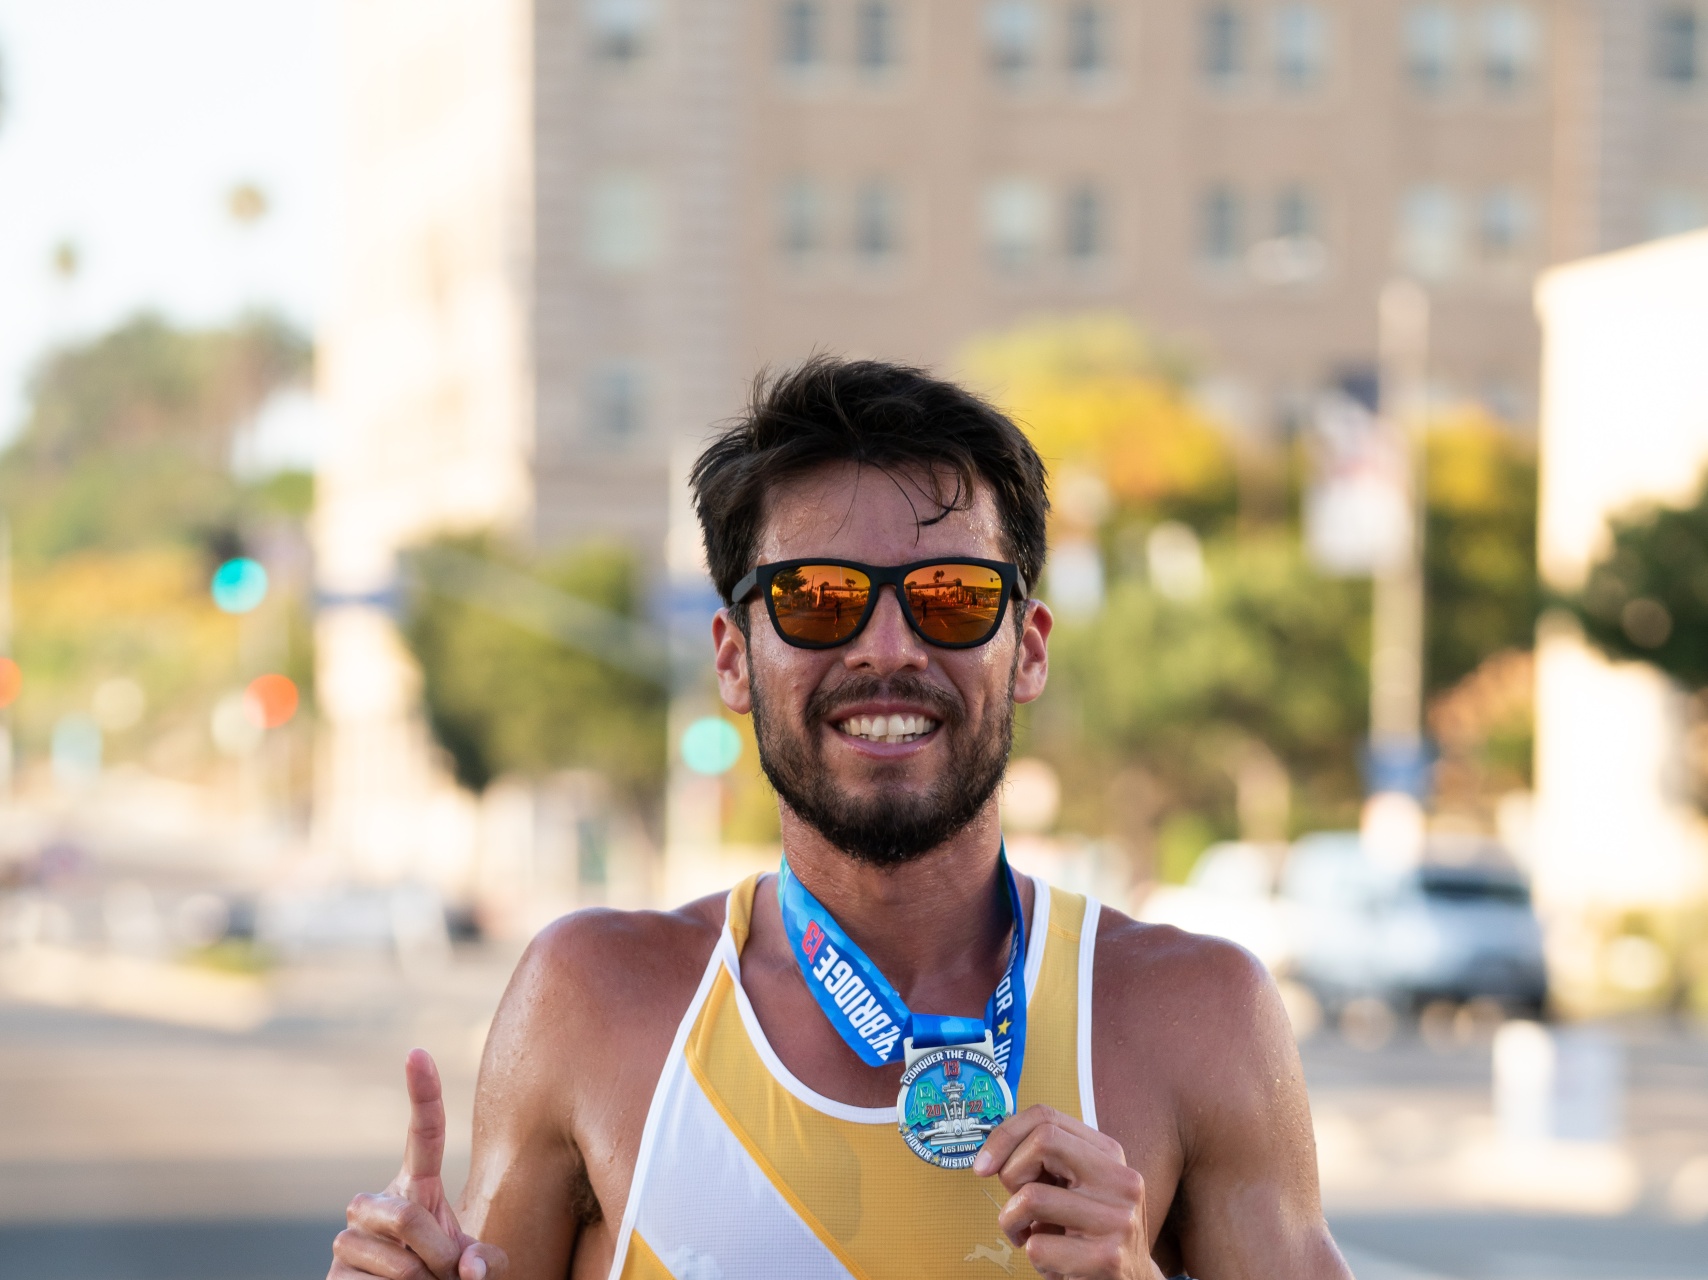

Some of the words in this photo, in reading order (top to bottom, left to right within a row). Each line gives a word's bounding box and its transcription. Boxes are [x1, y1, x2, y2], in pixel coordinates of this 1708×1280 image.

[802, 919, 825, 965] 13
[812, 944, 893, 1039] BRIDGE
[903, 1051, 944, 1085] CONQUER
[944, 1049, 964, 1059] THE
[965, 1051, 1001, 1078] BRIDGE
[942, 1060, 960, 1077] 13
[925, 1103, 942, 1119] 20
[968, 1100, 983, 1114] 22
[906, 1133, 932, 1161] HONOR
[942, 1145, 956, 1154] USS
[957, 1143, 977, 1152] IOWA
